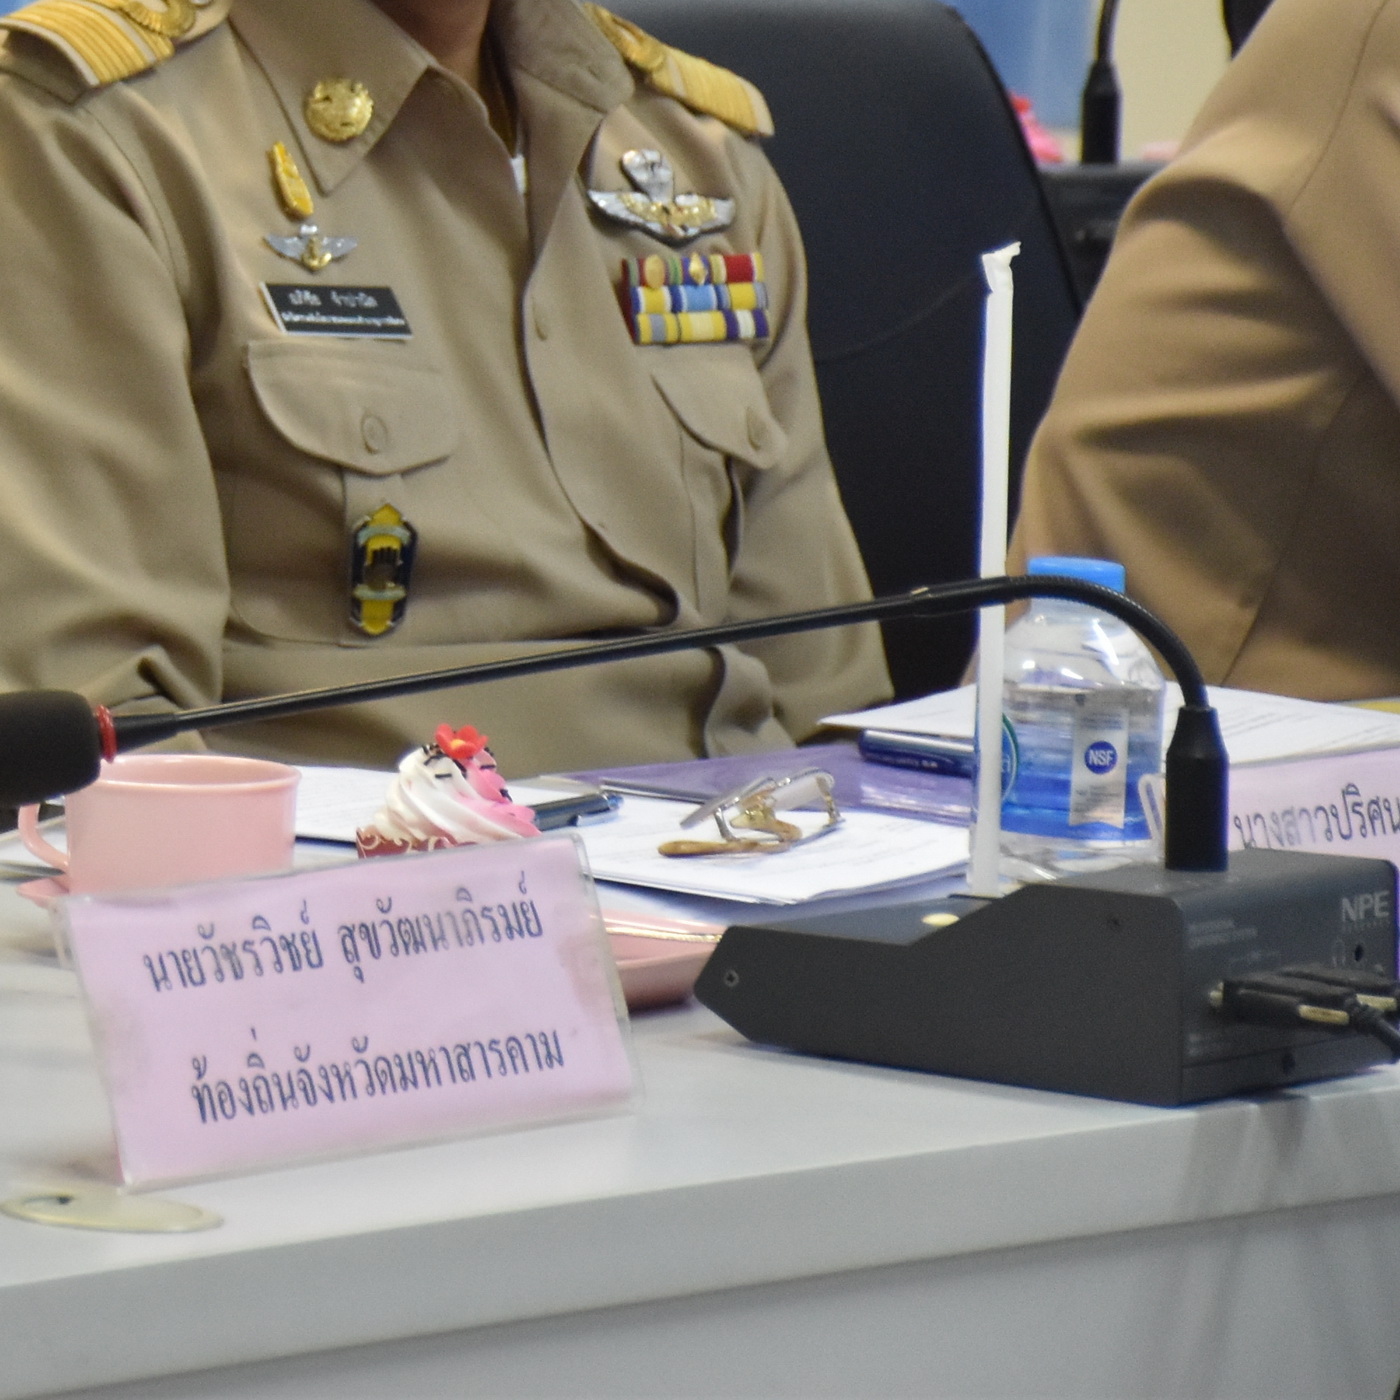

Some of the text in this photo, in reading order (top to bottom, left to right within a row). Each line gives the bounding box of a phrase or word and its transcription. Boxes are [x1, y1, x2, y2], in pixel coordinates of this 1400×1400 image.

[1087, 749, 1115, 767] NSF
[142, 870, 544, 993] นายวัชรวิชย์ สุขวัฒนาภิรมย์
[1341, 889, 1391, 923] NPE
[190, 1027, 565, 1125] ท้องถิ่นจังหวัดมหาสารคาม
